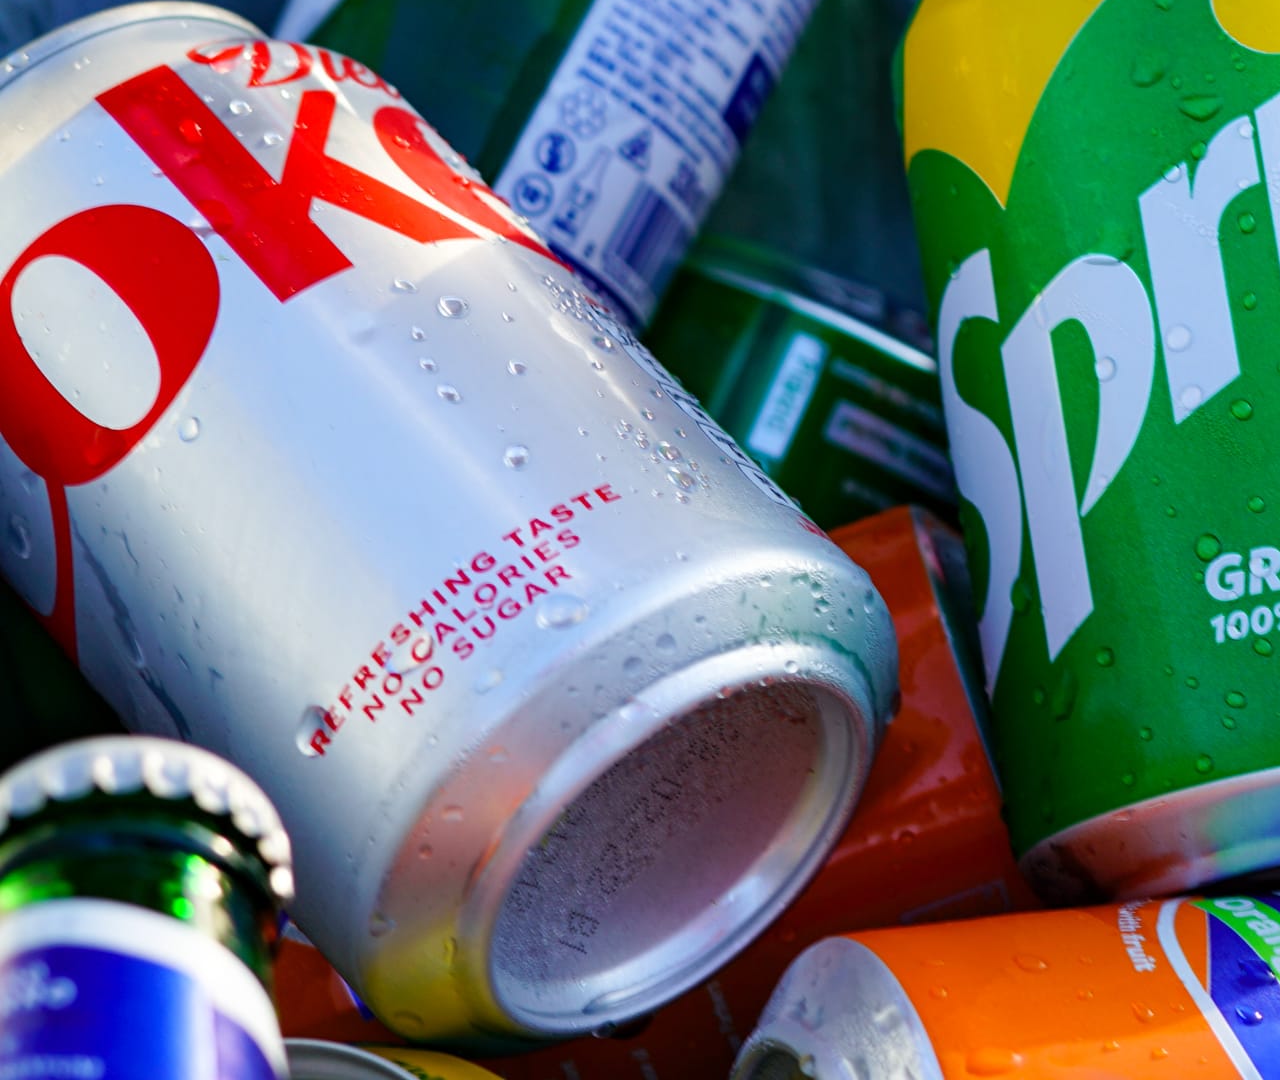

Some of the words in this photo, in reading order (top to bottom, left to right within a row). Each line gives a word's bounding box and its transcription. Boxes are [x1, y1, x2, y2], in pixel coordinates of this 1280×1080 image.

[187, 38, 402, 98] Die
[309, 551, 497, 757] REFRESHING
[502, 483, 621, 548] TASTE
[361, 673, 403, 723] NO
[411, 528, 581, 664] CALORIES
[400, 666, 445, 717] NO
[451, 564, 572, 661] SUGAR
[1121, 932, 1157, 973] fruit
